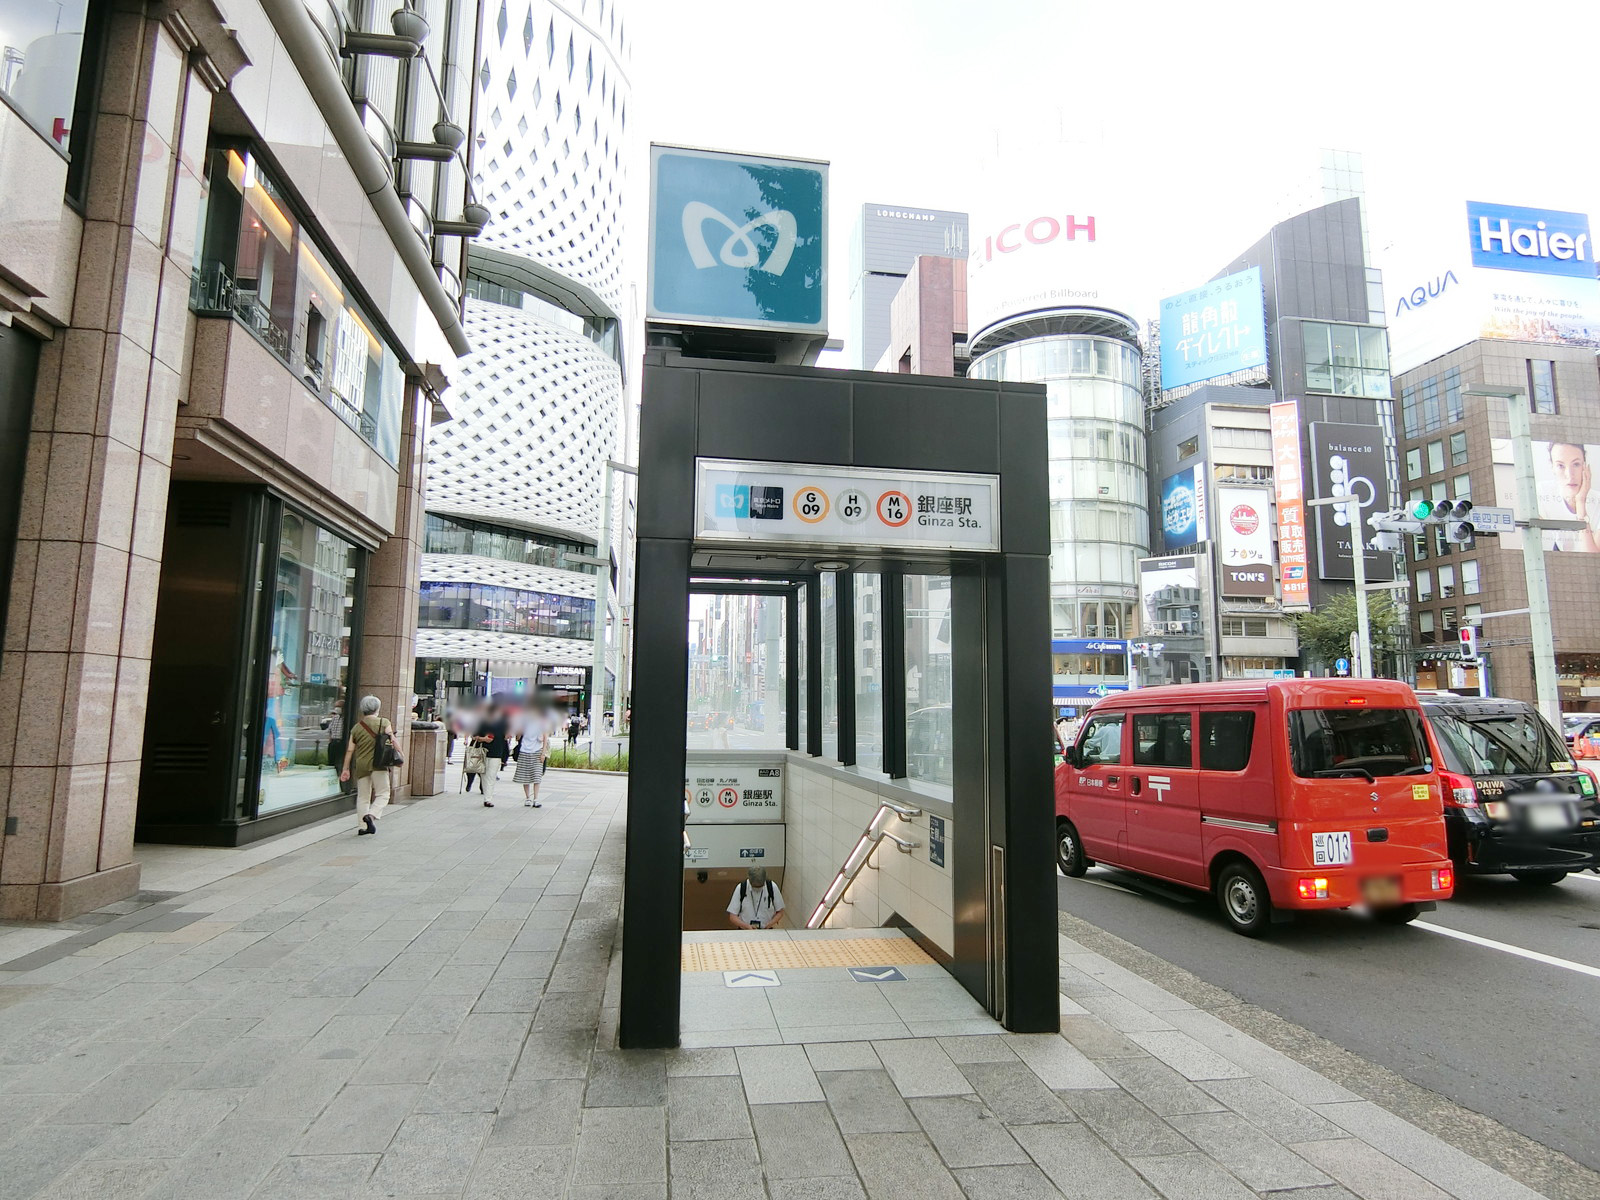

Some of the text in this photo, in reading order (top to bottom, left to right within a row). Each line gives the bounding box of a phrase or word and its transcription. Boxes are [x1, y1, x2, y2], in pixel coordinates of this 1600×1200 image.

[877, 209, 936, 222] LONGCHAMP
[984, 215, 1096, 263] ICOH
[1478, 216, 1587, 261] Haier
[1050, 288, 1099, 299] Billboard
[1396, 269, 1459, 317] AQUA
[1538, 309, 1547, 318] of
[1547, 310, 1559, 318] the
[1328, 442, 1372, 453] balance 10
[805, 492, 817, 503] G
[849, 494, 858, 505] H
[888, 496, 900, 507] M
[1196, 479, 1205, 525] FUJITEC
[802, 504, 820, 515] 09
[917, 494, 972, 516] 銀座駅
[844, 506, 862, 517] 09
[887, 508, 903, 519] 16
[917, 514, 982, 529] Ginza Sta.
[1472, 512, 1511, 525] 座四丁目
[1280, 525, 1303, 539] 買取
[1280, 539, 1304, 553] 販売
[1230, 571, 1266, 583] TON'S
[1290, 582, 1307, 592] B1F
[553, 666, 586, 676] NISSAN
[769, 769, 780, 777] A8
[1476, 780, 1506, 789] DAIWA
[742, 789, 773, 799] 銀座駅
[1482, 788, 1503, 796] 1373
[1327, 833, 1350, 863] 013
